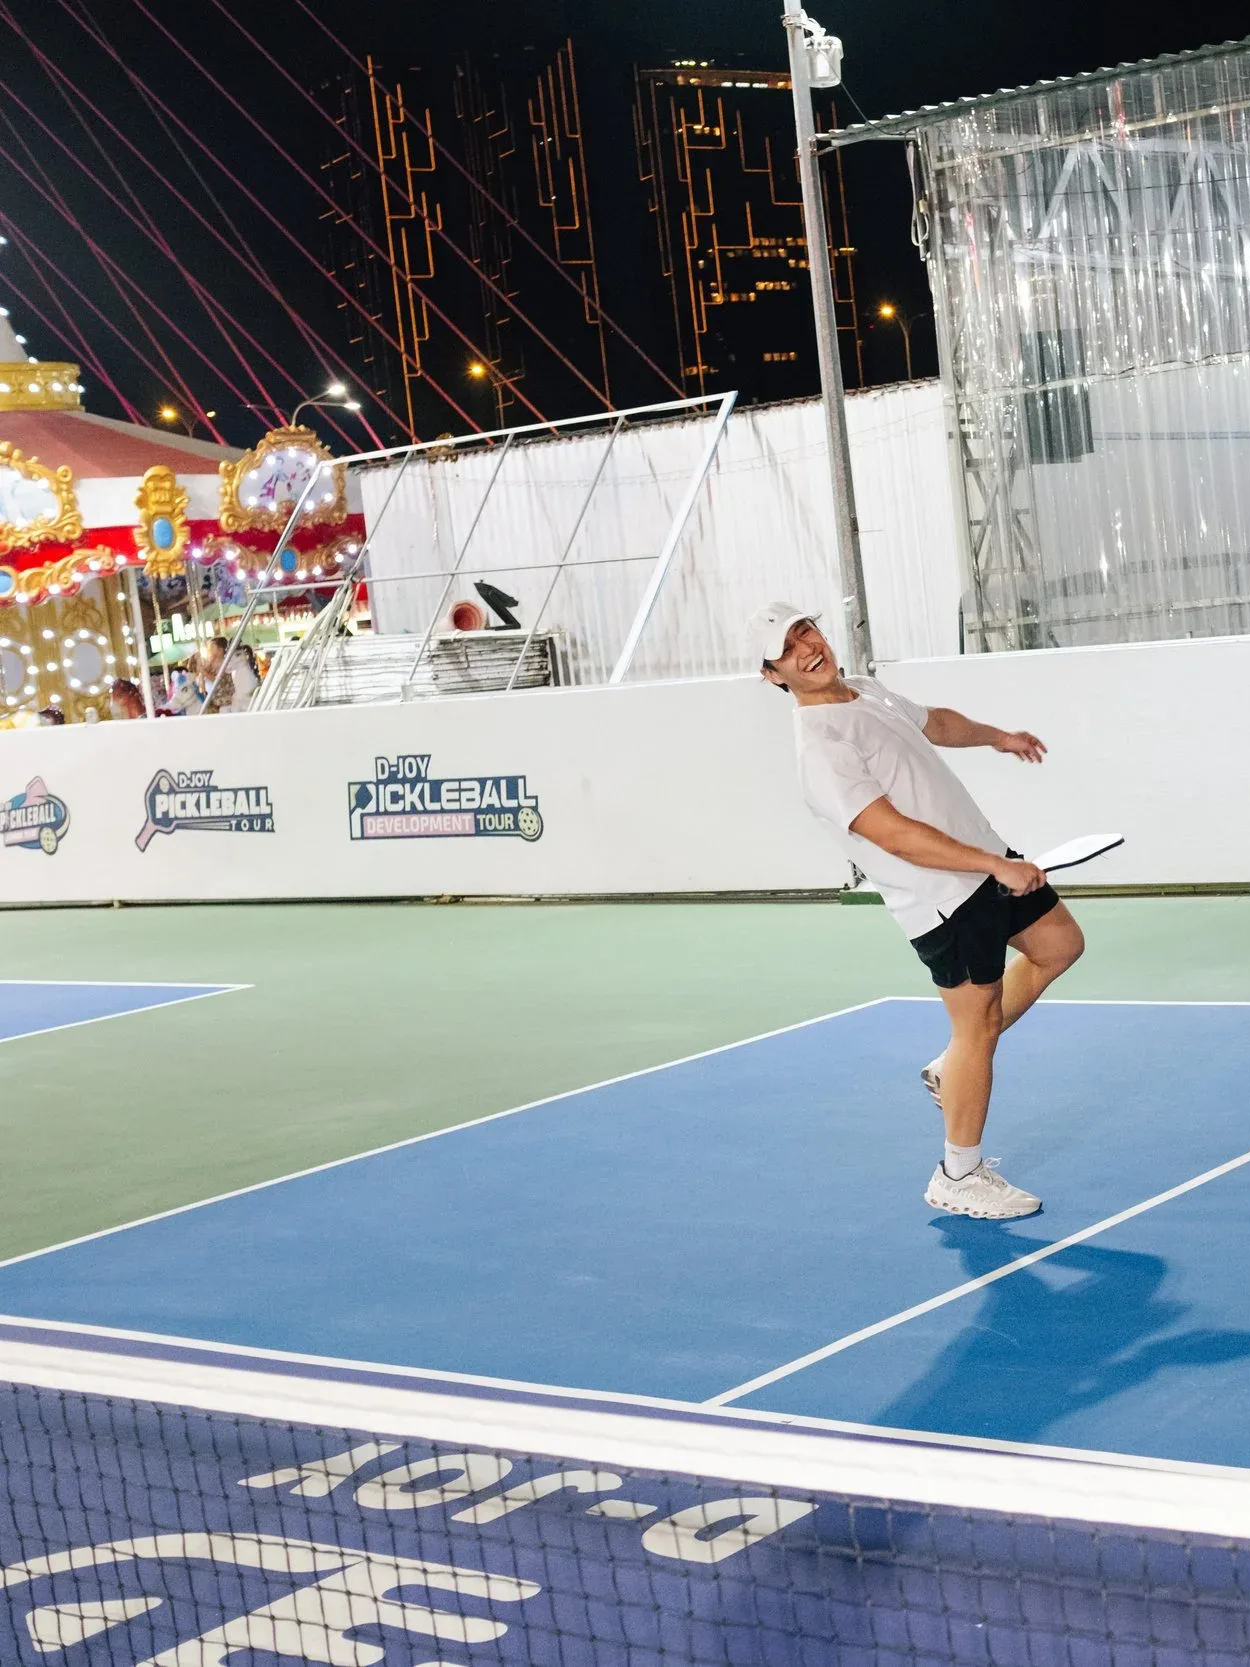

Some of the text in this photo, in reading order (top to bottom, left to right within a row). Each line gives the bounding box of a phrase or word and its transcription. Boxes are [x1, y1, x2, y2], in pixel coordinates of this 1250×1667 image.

[177, 772, 211, 788] D-JOY
[376, 756, 431, 780] D-JOY
[155, 788, 272, 819] PICKLEBALL
[350, 778, 537, 831] PICKLEBALL
[230, 818, 273, 832] TOUR
[366, 813, 514, 834] DEVELOPMENT TOUR
[236, 1440, 820, 1563] D-JOY
